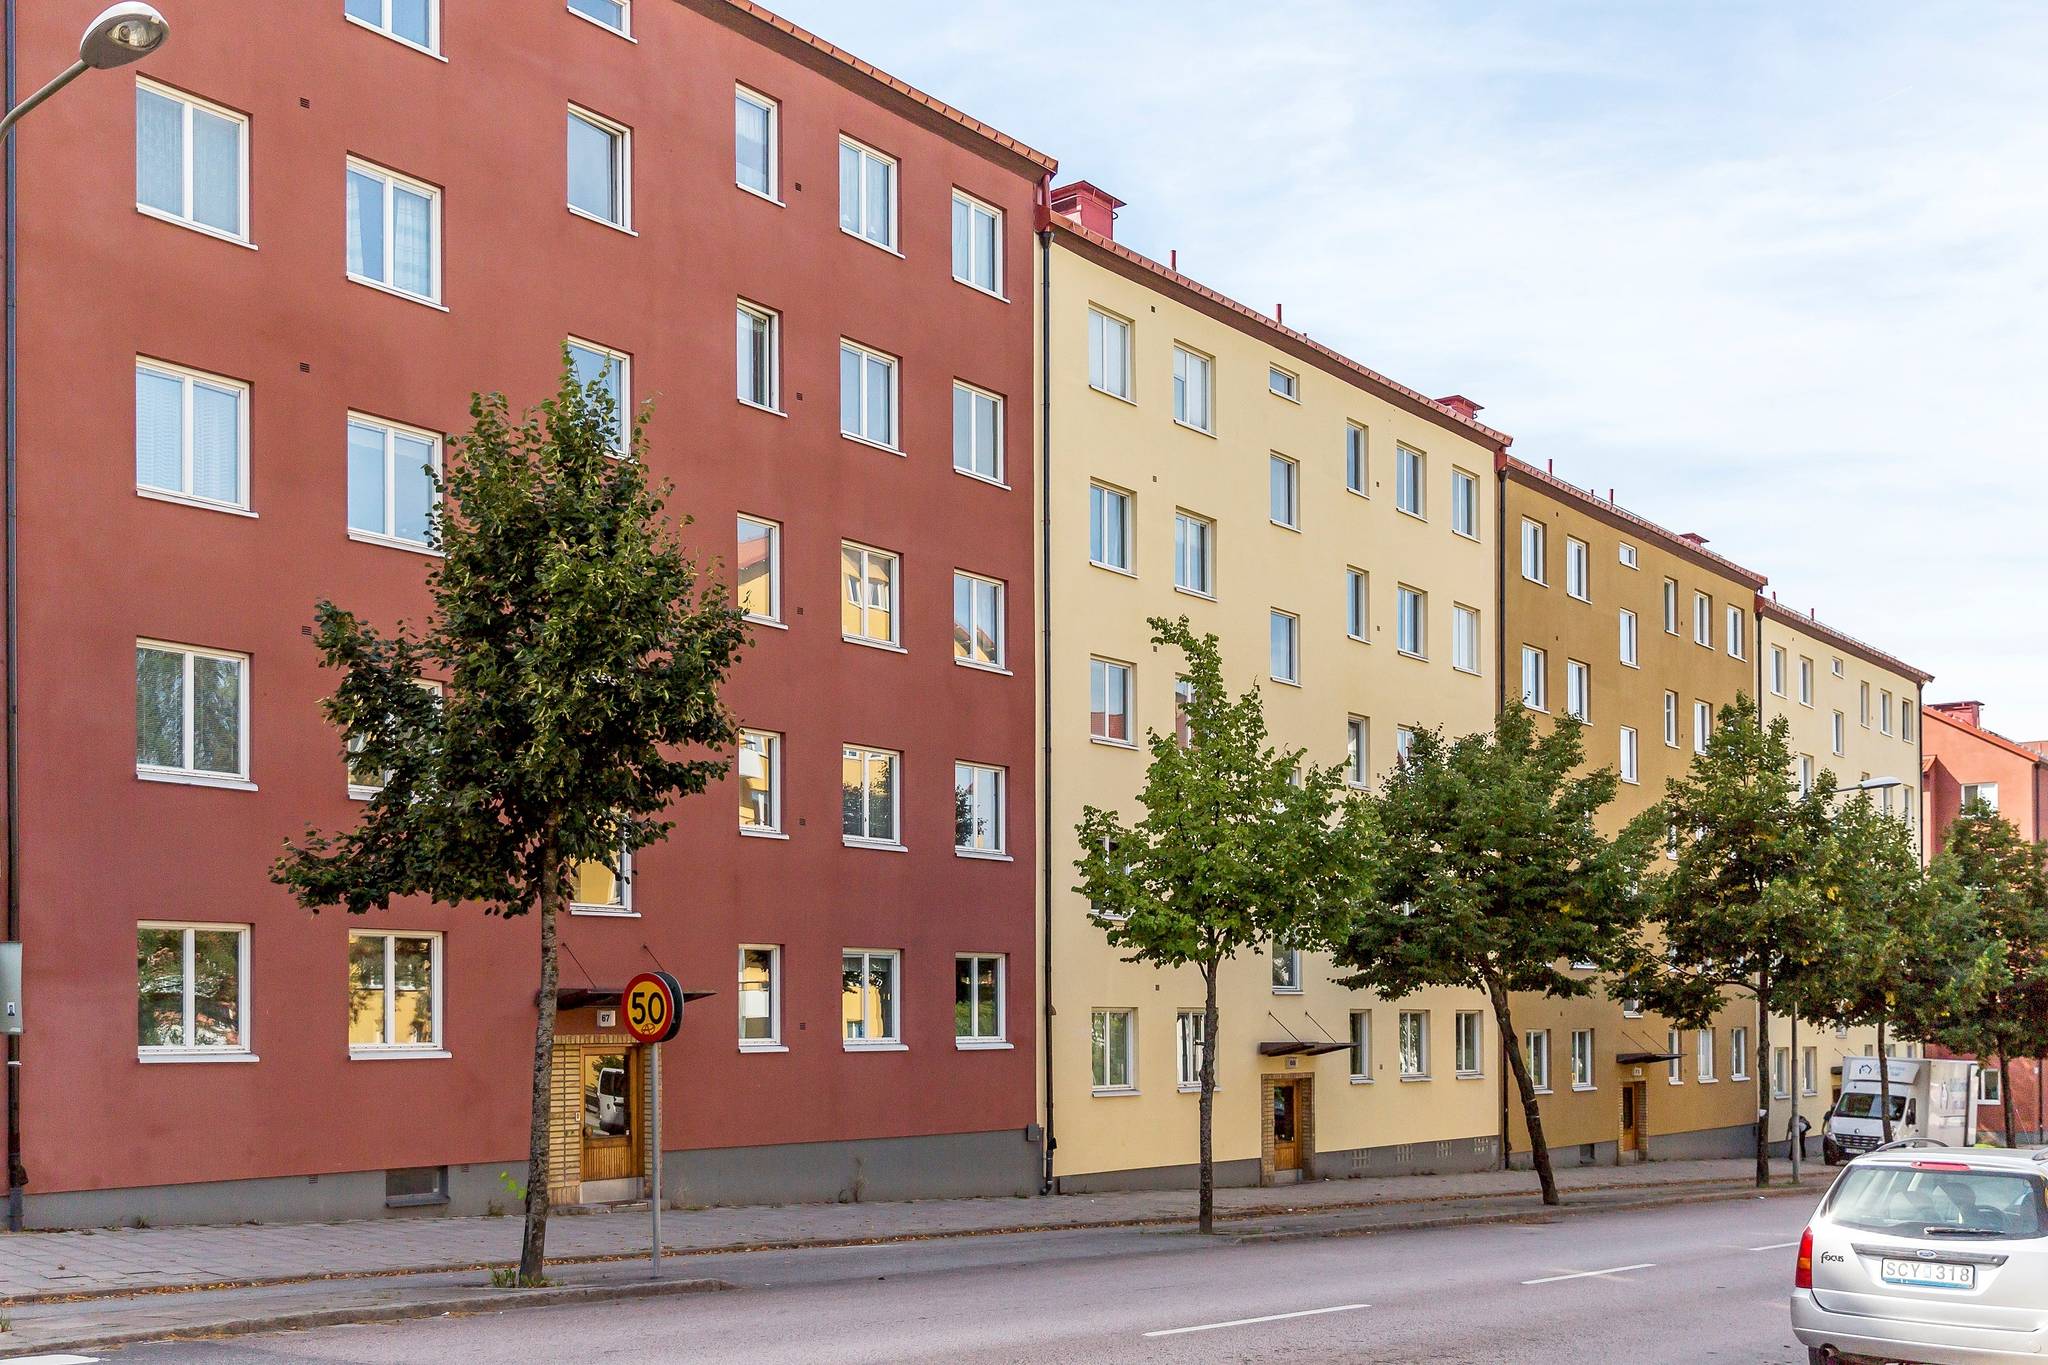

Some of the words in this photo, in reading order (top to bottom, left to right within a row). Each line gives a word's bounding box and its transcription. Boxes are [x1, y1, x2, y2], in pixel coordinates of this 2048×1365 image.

[601, 1014, 610, 1022] 67
[632, 992, 664, 1024] 50
[1886, 1262, 1920, 1278] SCY
[1936, 1265, 1970, 1282] 318
